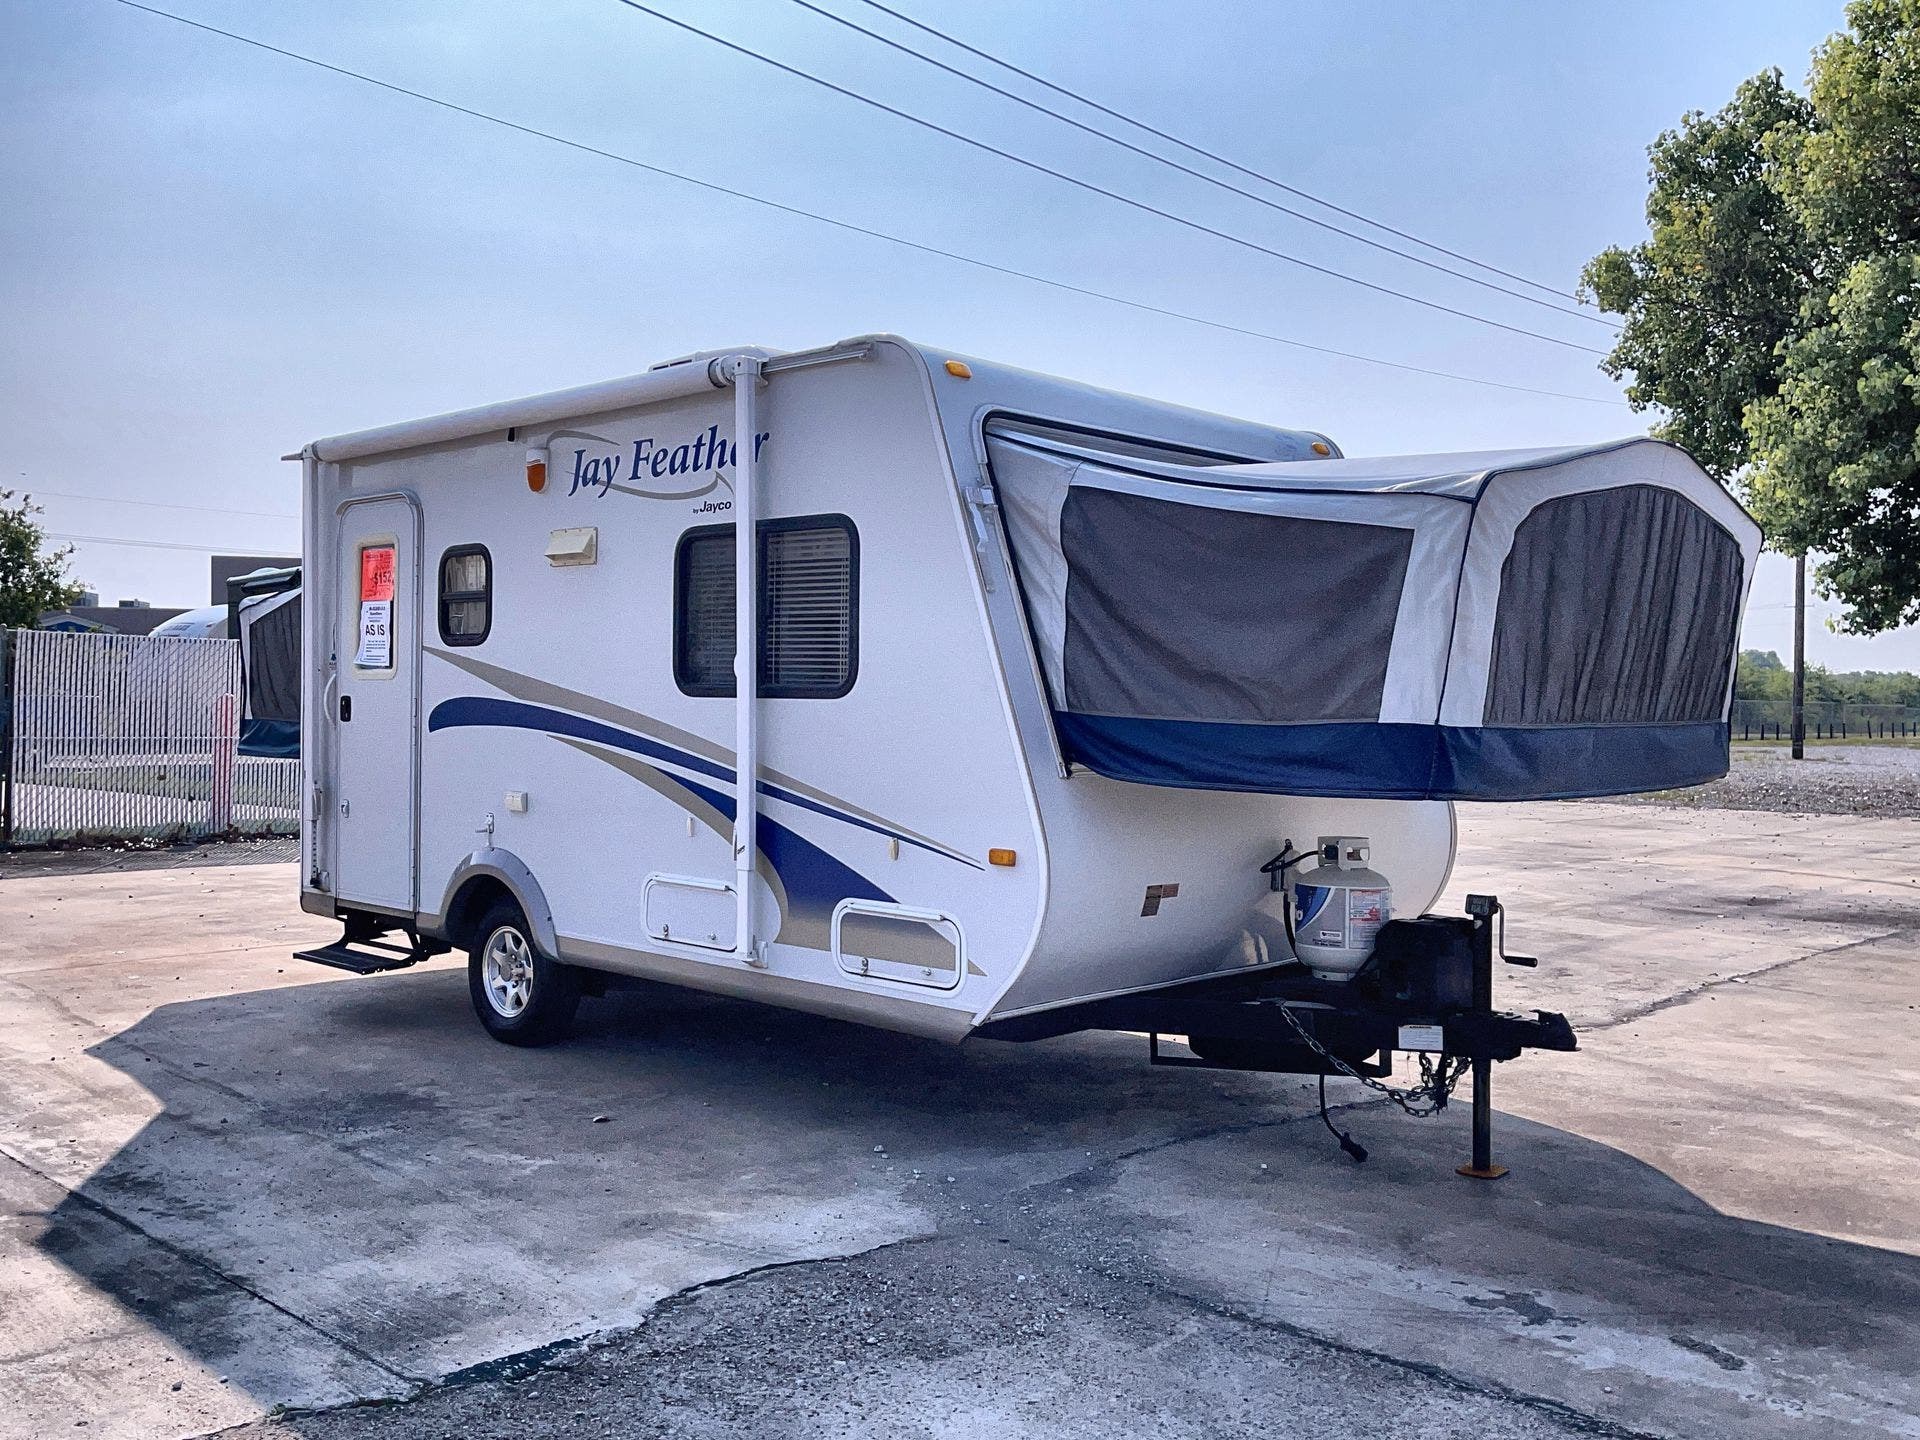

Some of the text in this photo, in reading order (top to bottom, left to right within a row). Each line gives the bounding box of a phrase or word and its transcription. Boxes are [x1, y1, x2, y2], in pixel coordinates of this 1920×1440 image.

[568, 449, 620, 498] Jay
[700, 500, 732, 513] Jayco
[365, 624, 385, 636] AS IS
